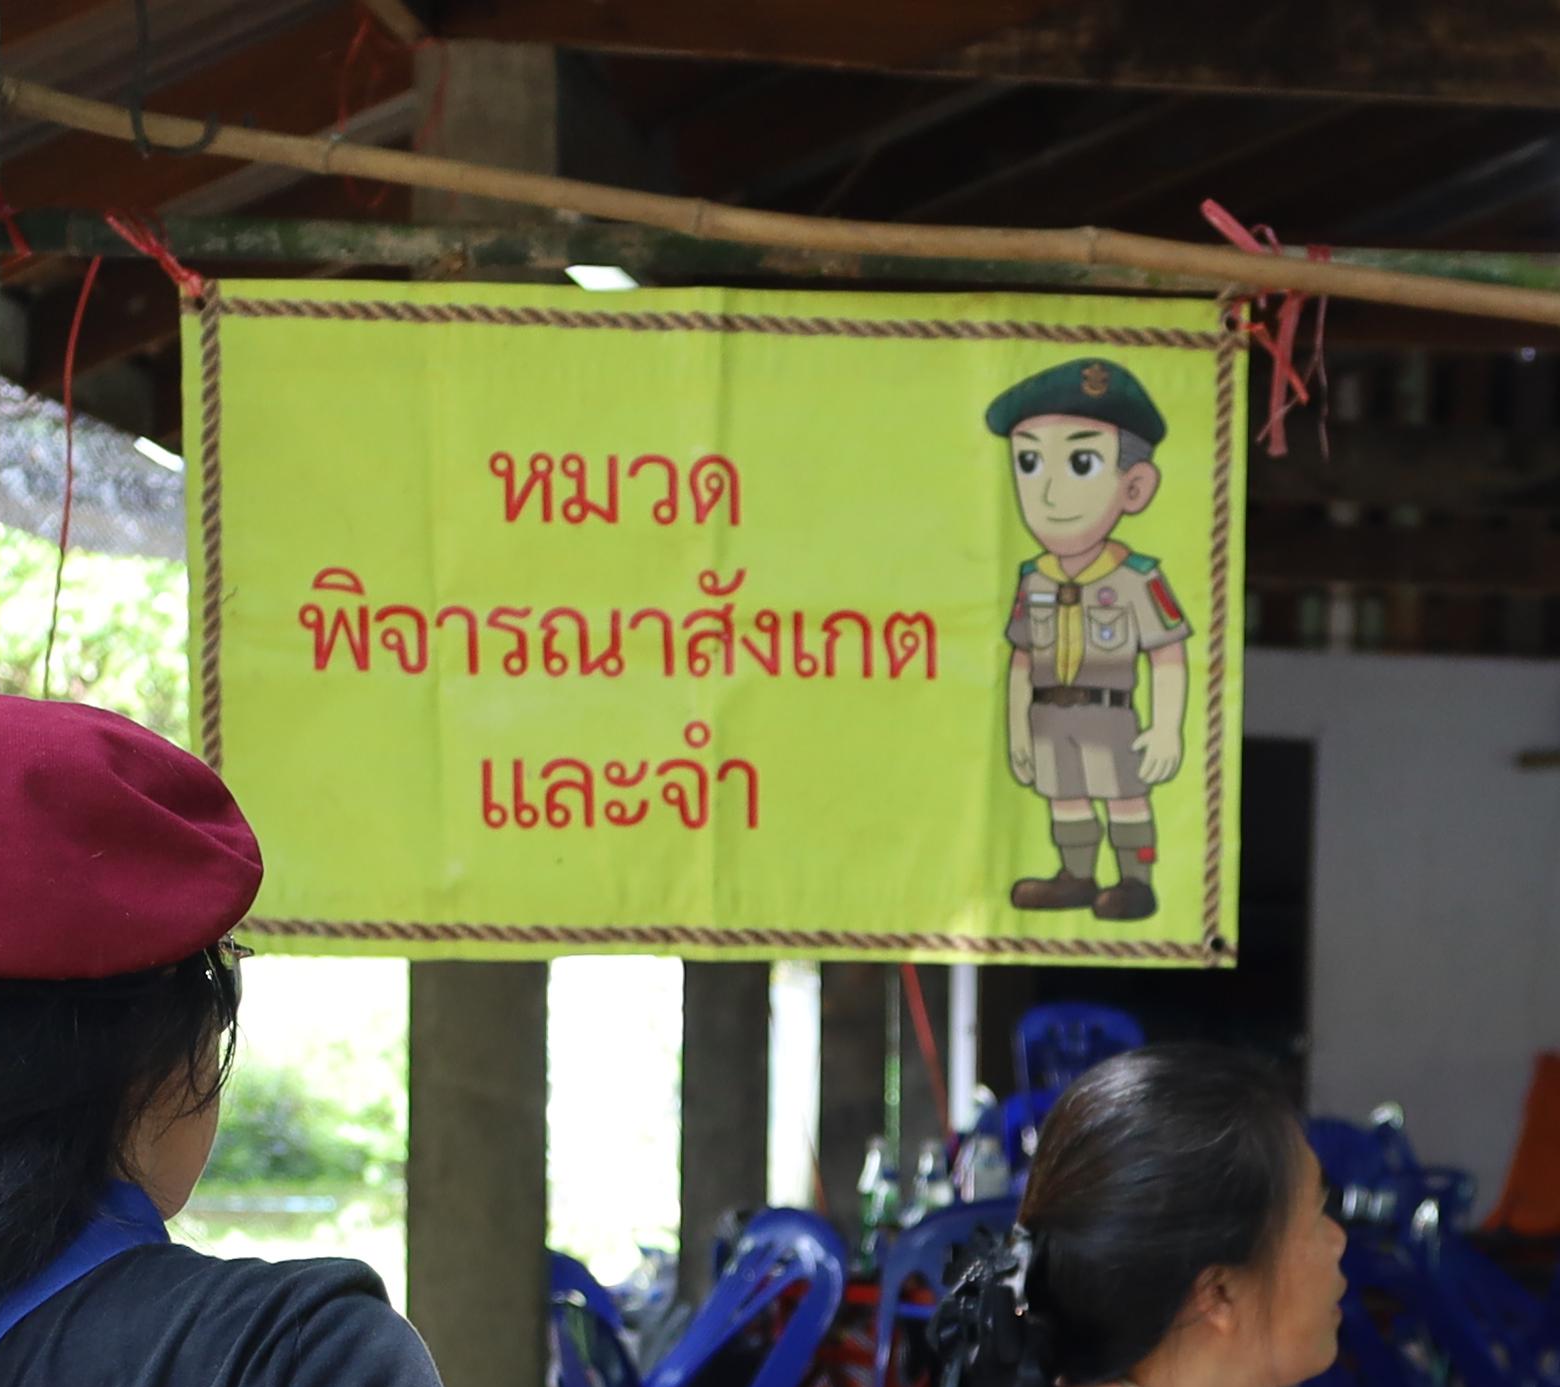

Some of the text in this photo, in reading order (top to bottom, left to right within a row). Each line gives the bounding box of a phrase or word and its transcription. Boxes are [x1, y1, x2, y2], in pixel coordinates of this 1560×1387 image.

[489, 451, 741, 527] หมวด
[298, 567, 939, 680] พิจารณาสังเกต
[480, 721, 759, 830] และจำ
